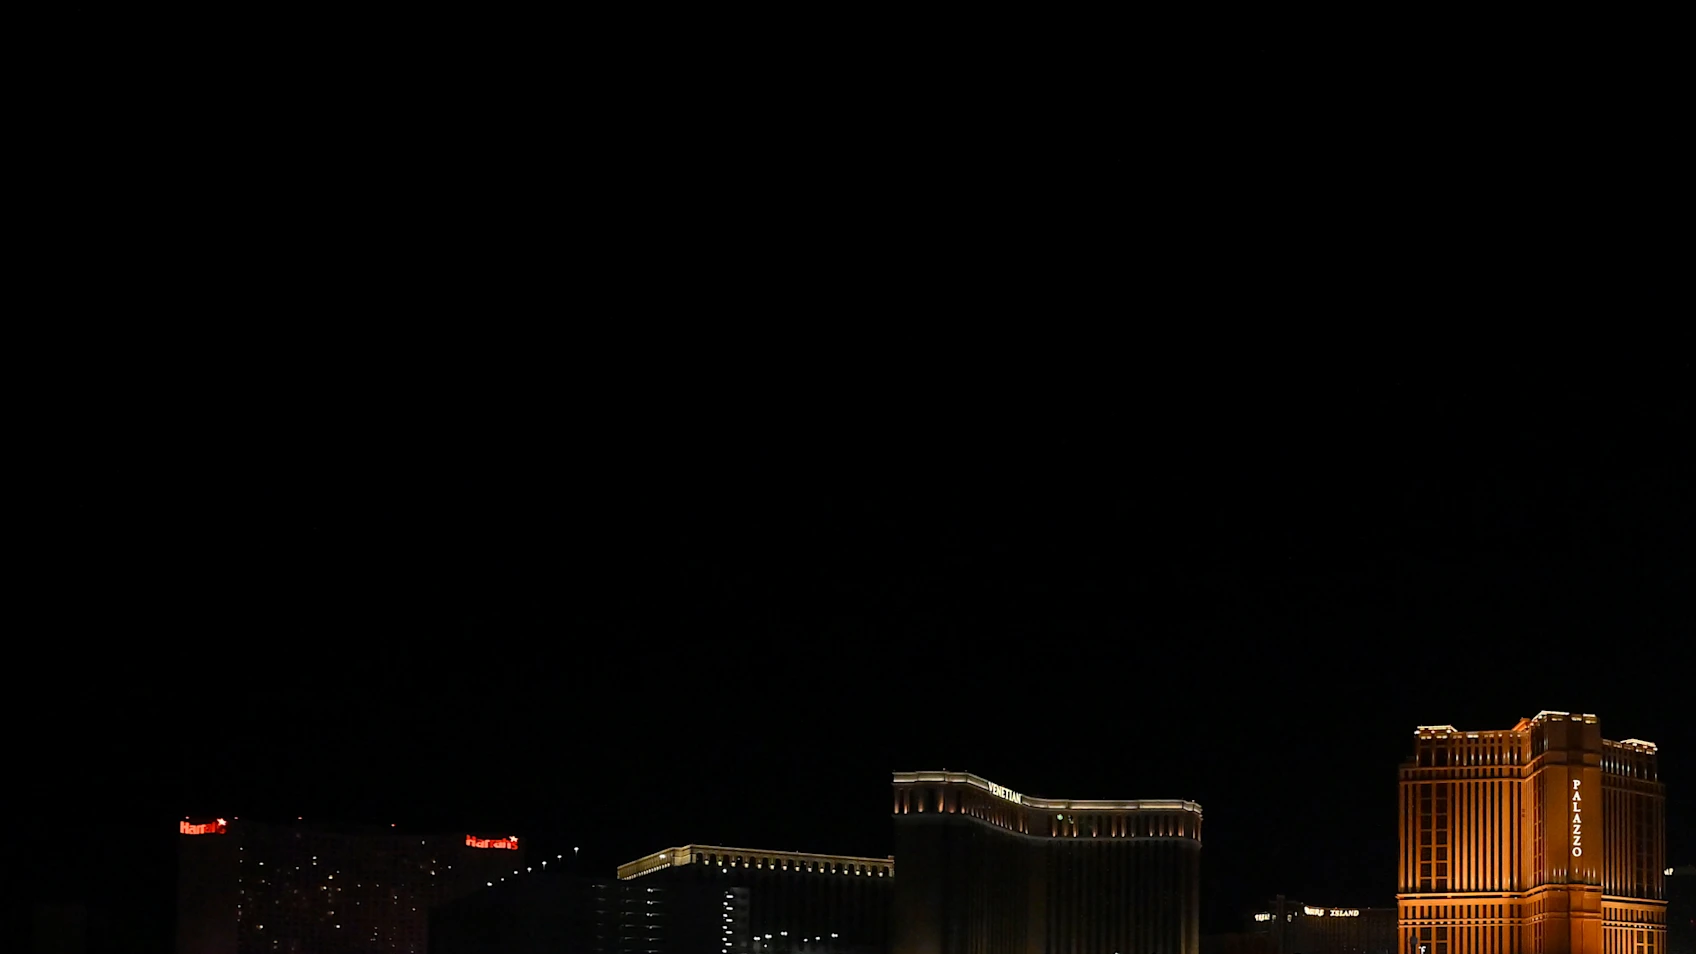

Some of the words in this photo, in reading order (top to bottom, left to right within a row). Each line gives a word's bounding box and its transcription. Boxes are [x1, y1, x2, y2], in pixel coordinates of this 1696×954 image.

[988, 781, 1022, 805] VENETIAN
[1572, 779, 1582, 857] PALAZZO
[1329, 909, 1360, 917] ISLAND
